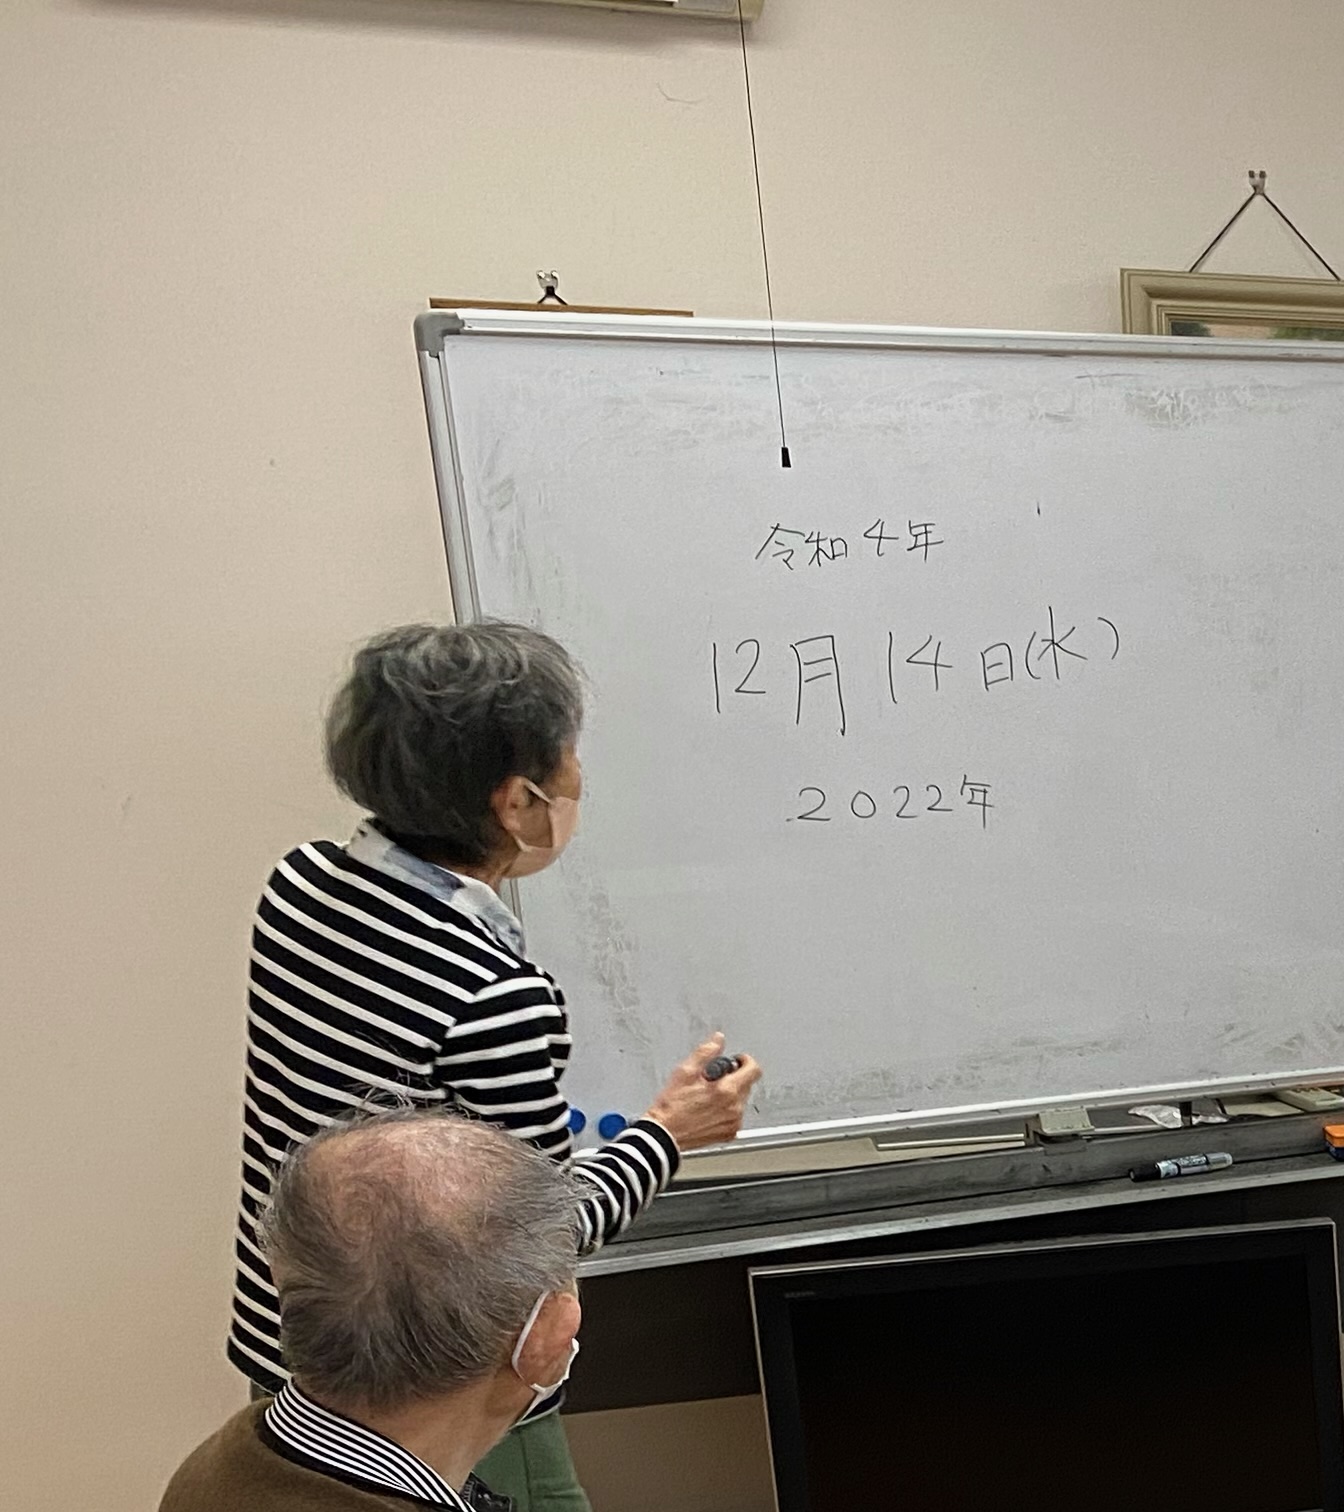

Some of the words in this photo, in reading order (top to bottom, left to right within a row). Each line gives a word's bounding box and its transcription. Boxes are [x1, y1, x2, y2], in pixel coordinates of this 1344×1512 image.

[755, 518, 944, 570] 令和4年
[788, 774, 995, 829] 2022年
